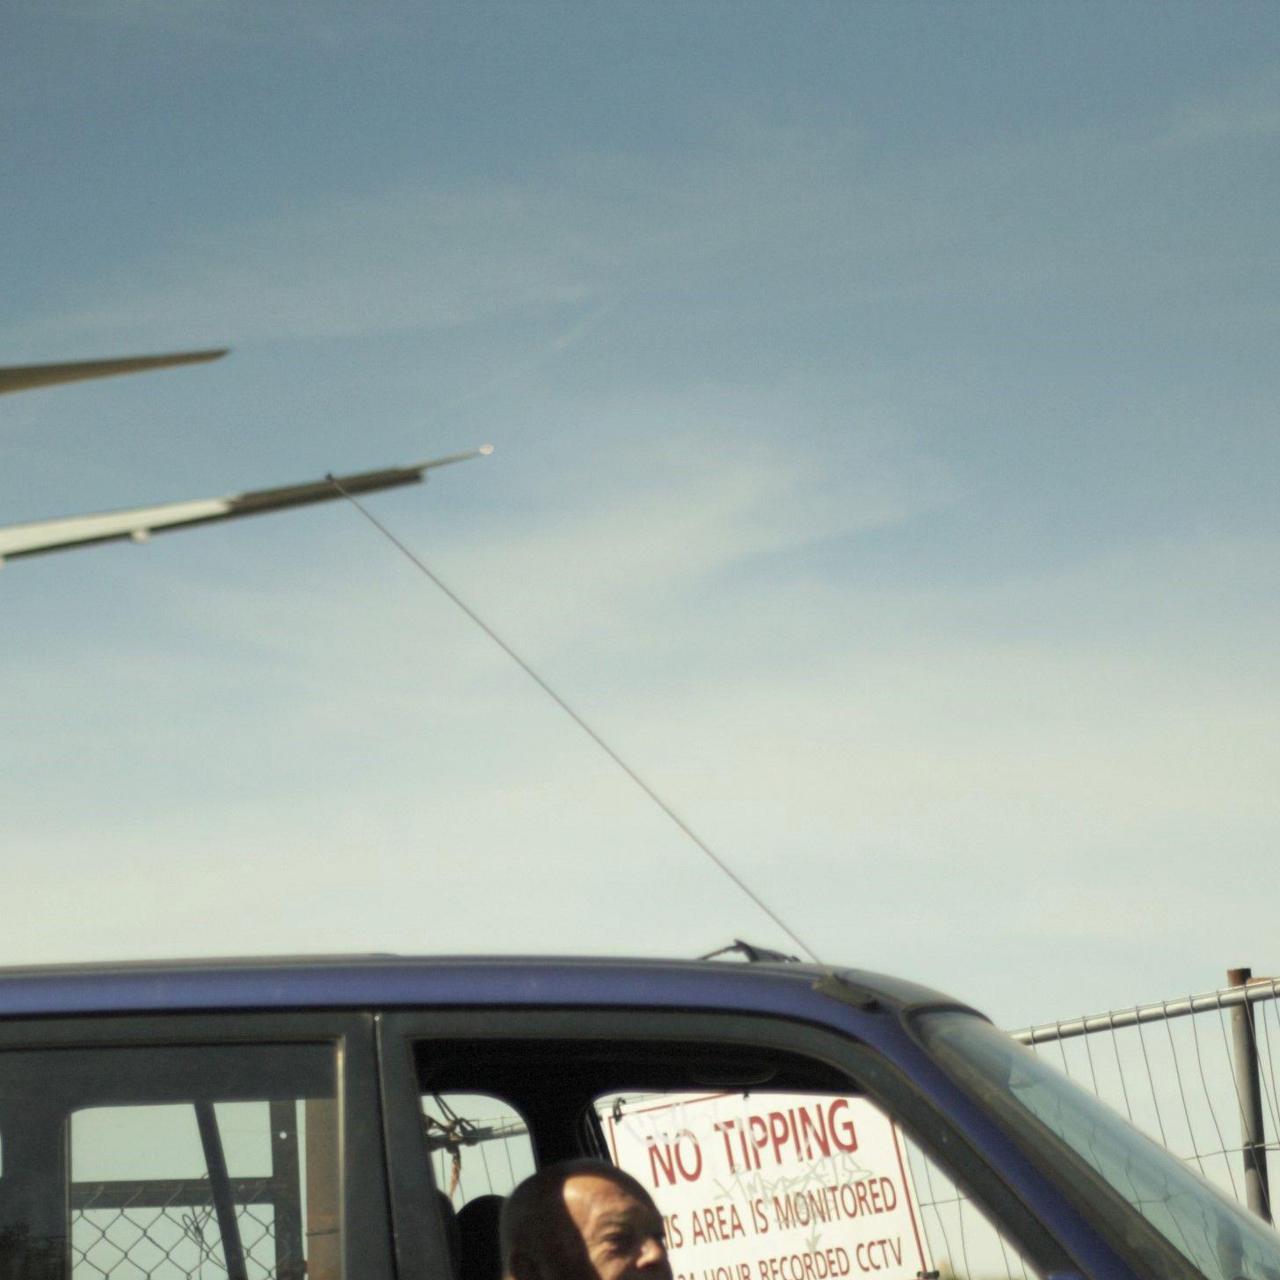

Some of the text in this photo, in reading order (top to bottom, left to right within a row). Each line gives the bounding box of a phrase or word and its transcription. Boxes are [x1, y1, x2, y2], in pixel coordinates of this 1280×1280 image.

[646, 1130, 702, 1187] NO
[714, 1099, 858, 1174] TIPPING
[662, 1213, 684, 1250] IS
[692, 1204, 746, 1245] AREA
[749, 1198, 769, 1235] IS
[773, 1176, 897, 1231] MONITORED
[856, 1237, 902, 1272] CCTV
